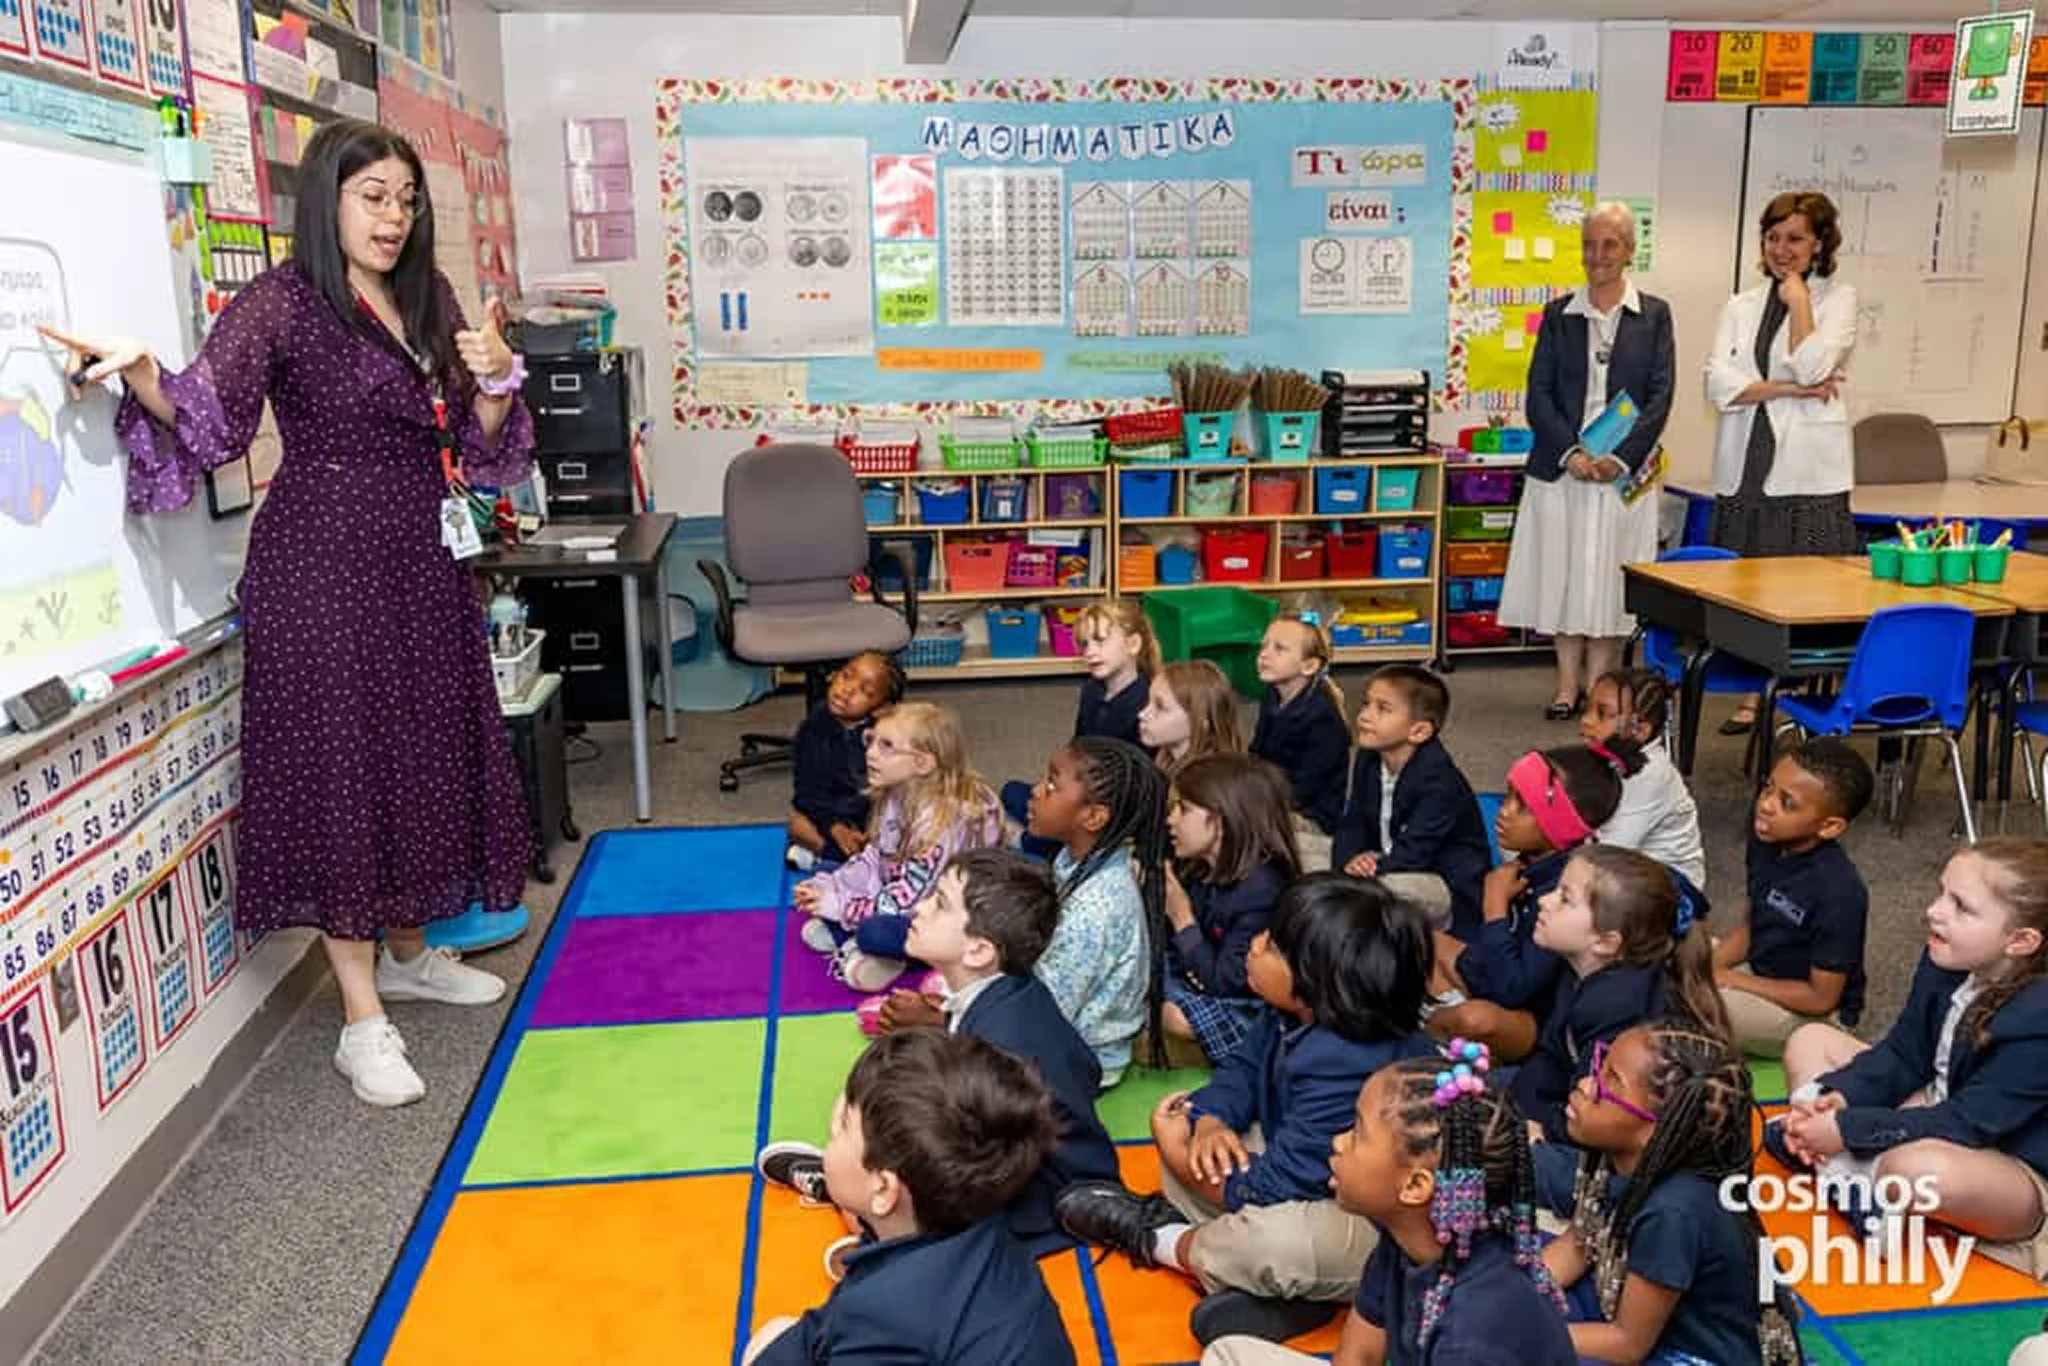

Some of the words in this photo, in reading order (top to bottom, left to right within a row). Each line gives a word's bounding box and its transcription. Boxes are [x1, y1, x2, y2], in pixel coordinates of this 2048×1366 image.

[1683, 35, 1707, 52] 10
[1730, 33, 1753, 52] 20
[1874, 37, 1897, 55] 50
[1922, 37, 1944, 55] 60
[922, 112, 1233, 156] ΜΑΘΗΜΑΤΙΚΑ
[1297, 150, 1348, 175] Τι
[1361, 150, 1424, 175] ώρα
[1097, 189, 1105, 204] 5
[1219, 186, 1226, 203] 7
[1329, 199, 1389, 221] είναι
[1216, 265, 1230, 282] 10
[13, 780, 31, 809] 15
[42, 765, 60, 793] 16
[69, 749, 84, 775] 17
[93, 735, 108, 762] 18
[115, 722, 132, 748] 19
[141, 708, 156, 735] 20
[175, 687, 190, 711] 22
[197, 674, 211, 700] 23
[0, 869, 22, 903] 50
[31, 850, 46, 881] 51
[55, 831, 74, 864] 52
[83, 815, 102, 845] 53
[109, 799, 126, 828] 54
[132, 785, 145, 813] 55
[167, 756, 181, 783] 57
[187, 744, 200, 770] 58
[202, 732, 216, 758] 59
[4, 945, 26, 981] 85
[35, 925, 55, 957] 86
[61, 902, 77, 935] 87
[86, 884, 105, 915] 88
[112, 866, 129, 896] 89
[136, 849, 153, 877] 90
[160, 834, 172, 860] 91
[207, 791, 222, 815] 94
[198, 844, 222, 908] 18
[150, 880, 174, 955] 17
[93, 927, 124, 1007] 16
[0, 1006, 38, 1097] 15
